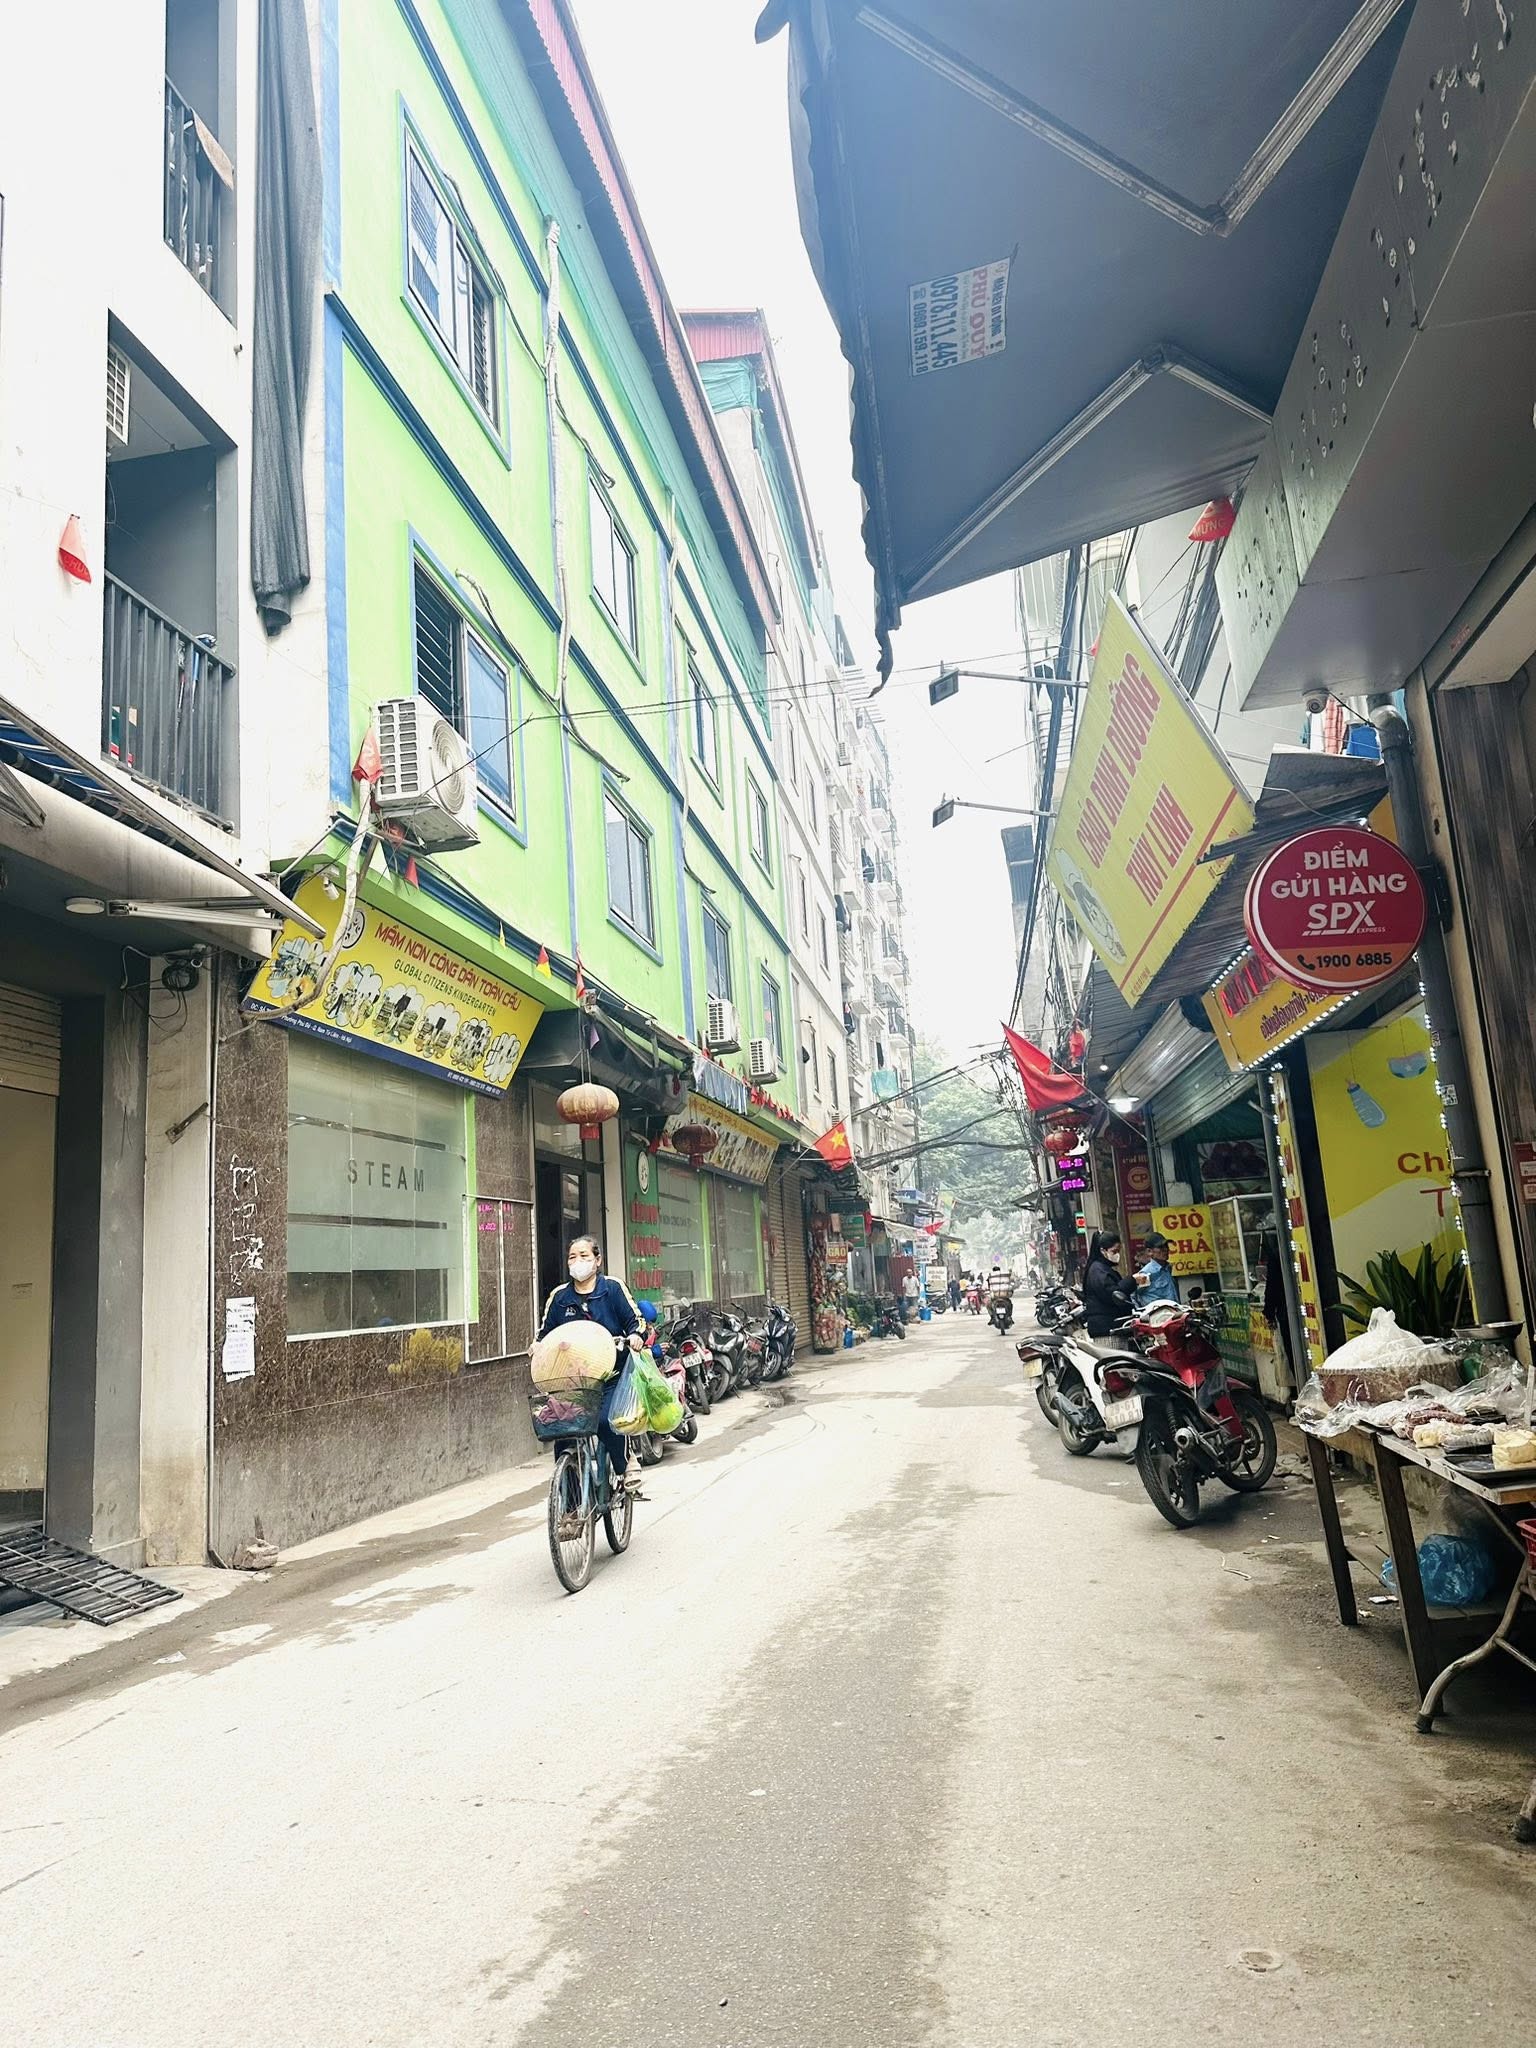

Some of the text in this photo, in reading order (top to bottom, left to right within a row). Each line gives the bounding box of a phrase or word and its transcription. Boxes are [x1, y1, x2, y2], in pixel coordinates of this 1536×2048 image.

[1090, 743, 1131, 828] DINH
[1076, 797, 1112, 870] CHÁO
[1146, 782, 1194, 870] LINH
[1303, 840, 1369, 871] ĐIỂM
[1271, 871, 1408, 899] GỬI HÀNG
[1307, 900, 1377, 935] SPX
[1356, 926, 1386, 934] EXPRESS
[374, 921, 522, 1012] MẦM NON CÔNG DÂN TOÀN CẦU
[1316, 952, 1393, 969] 1900 6885
[393, 958, 497, 1017] GLOBAL CITIZENS KINDERGARTEN
[347, 1159, 425, 1192] STEAM
[1131, 1173, 1148, 1184] CP
[1163, 1207, 1204, 1230] GIÒ
[1167, 1232, 1212, 1255] CHẢ
